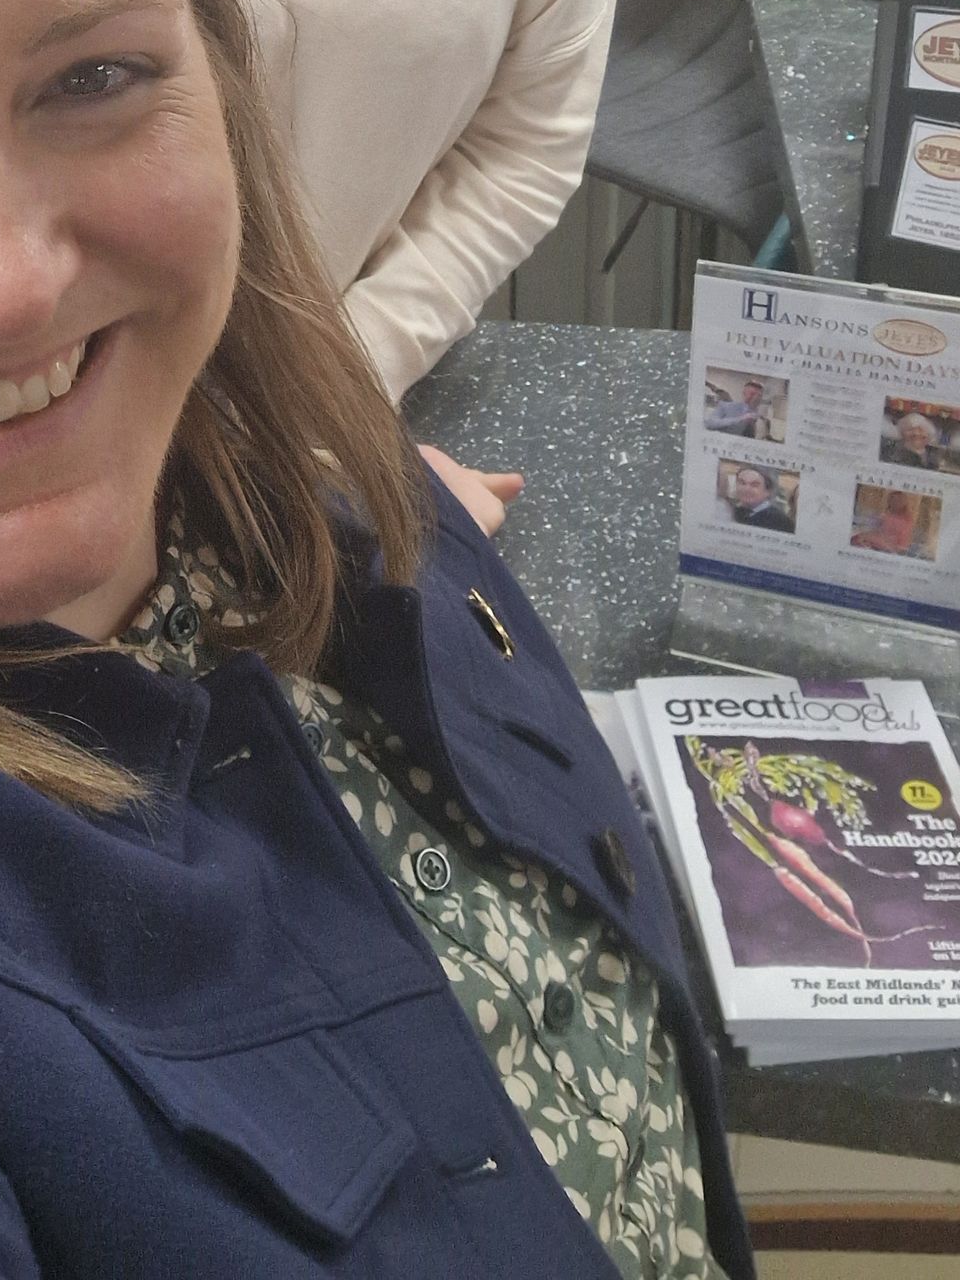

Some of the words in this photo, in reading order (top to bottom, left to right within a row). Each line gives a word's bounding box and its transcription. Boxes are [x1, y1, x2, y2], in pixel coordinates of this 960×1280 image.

[742, 288, 869, 337] HANSONS
[726, 331, 769, 350] FREE
[780, 339, 902, 371] VALUATION
[743, 350, 784, 364] WITH
[791, 358, 863, 378] CHARLES
[869, 370, 937, 391] HANSON
[907, 814, 958, 831] The
[791, 978, 821, 990] The
[826, 978, 861, 990] East
[865, 978, 946, 991] Midlands'
[811, 993, 849, 1009] food
[853, 994, 885, 1006] and
[889, 993, 932, 1006] drink
